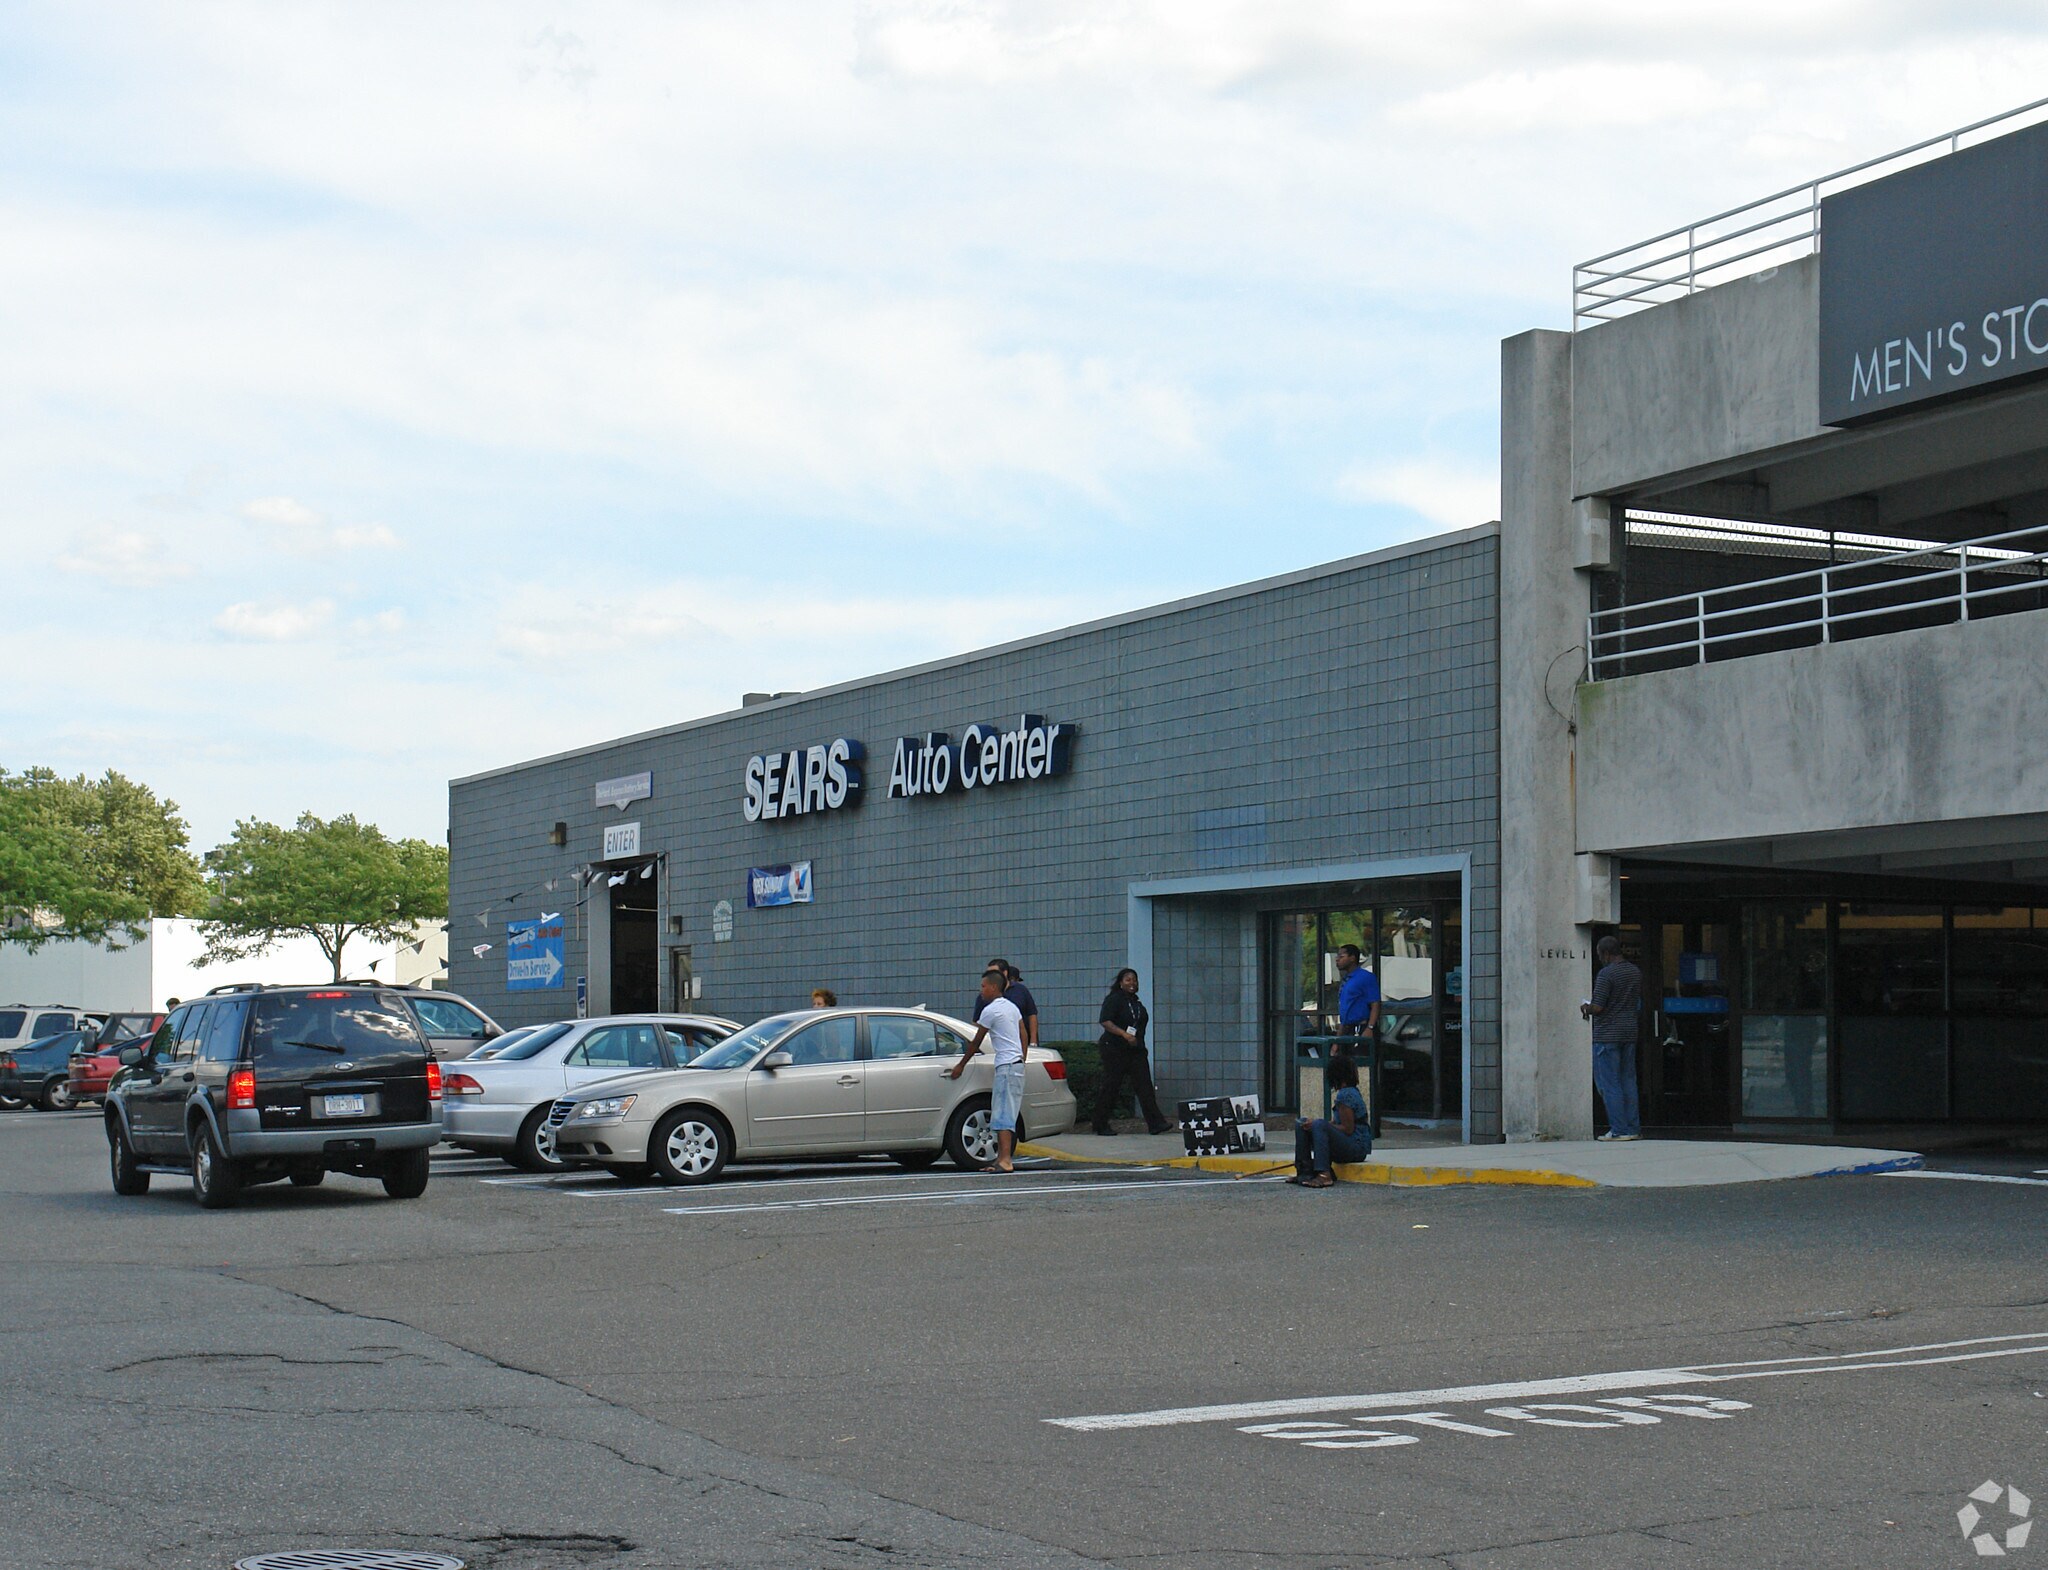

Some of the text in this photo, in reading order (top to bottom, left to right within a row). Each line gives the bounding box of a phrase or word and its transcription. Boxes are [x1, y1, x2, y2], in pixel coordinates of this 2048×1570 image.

[1850, 321, 1968, 402] MEN'S
[743, 713, 1060, 822] SEARS Auto Center
[606, 829, 635, 854] ENTER
[530, 960, 551, 977] Service
[1540, 948, 1576, 960] LEVEL
[1235, 1394, 1753, 1450] STOP
